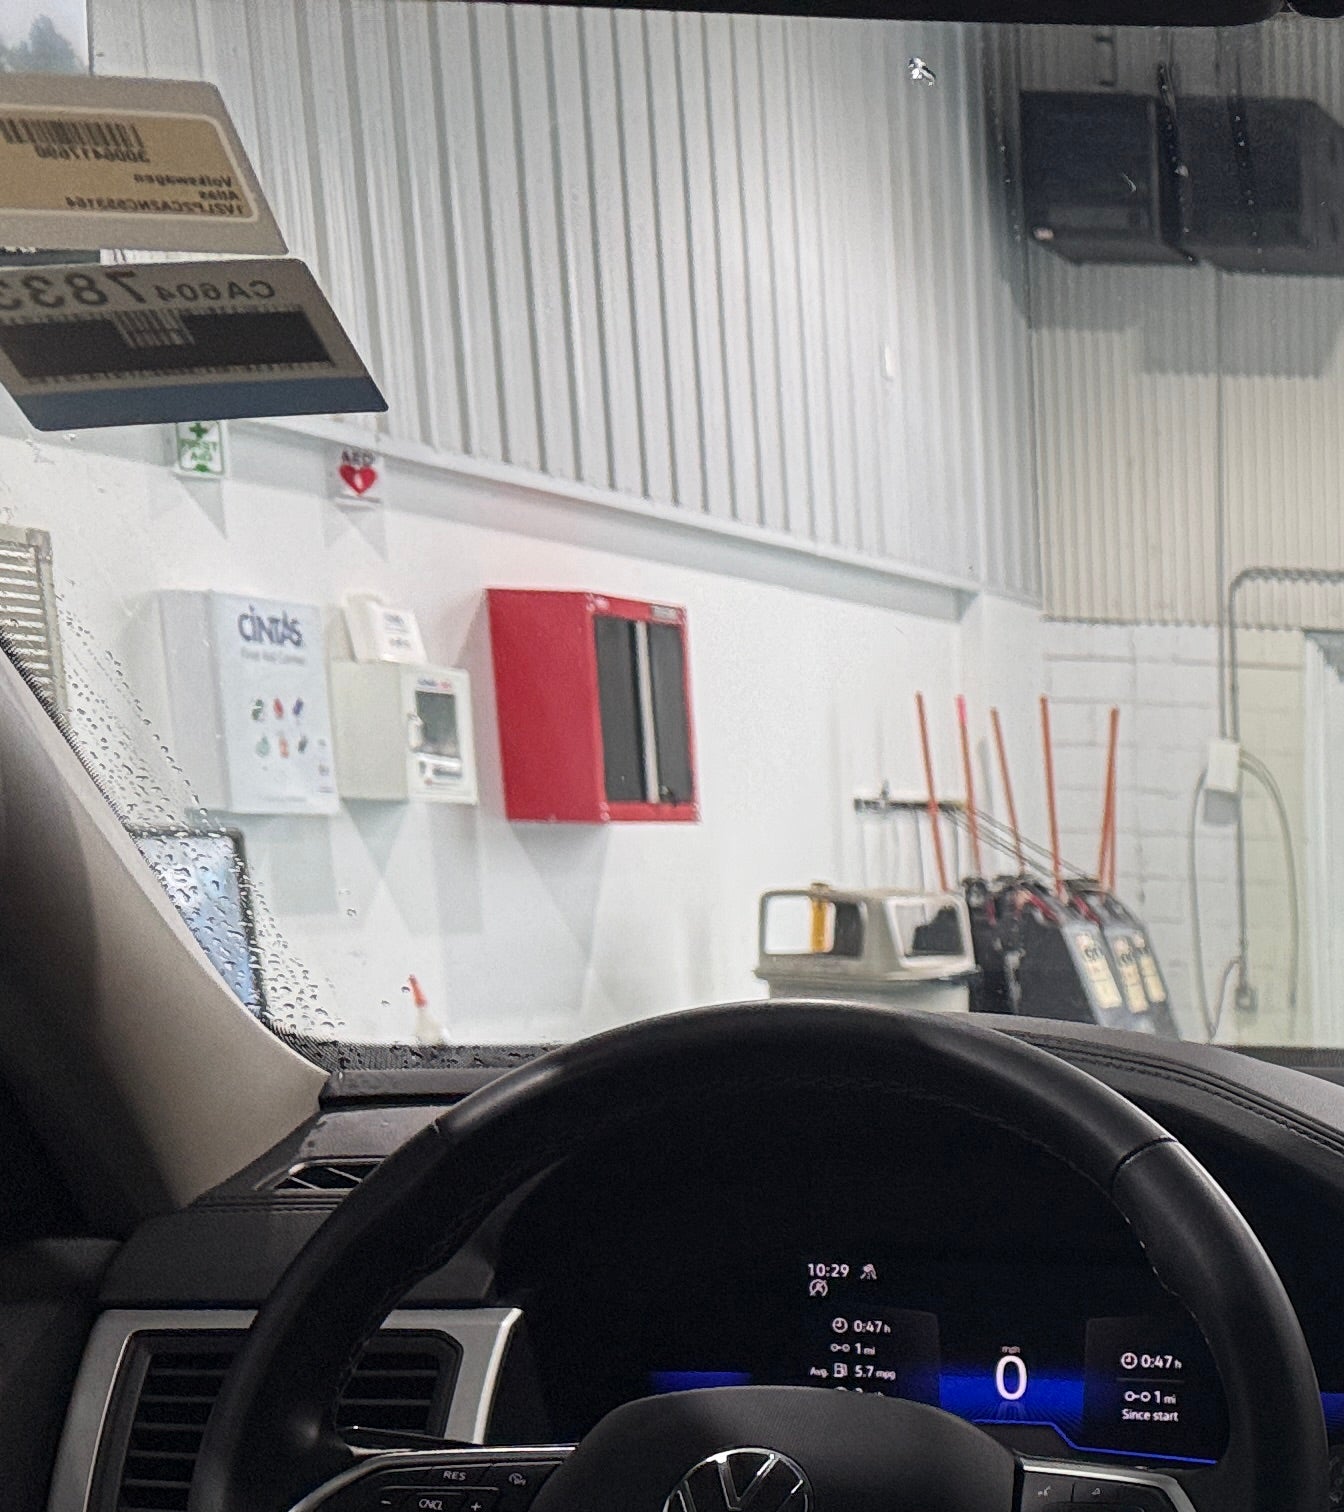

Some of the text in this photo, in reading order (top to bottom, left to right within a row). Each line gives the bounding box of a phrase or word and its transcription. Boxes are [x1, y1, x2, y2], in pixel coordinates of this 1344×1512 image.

[807, 1263, 850, 1278] 10:29
[853, 1319, 883, 1333] 0:47
[855, 1342, 862, 1355] 1
[1140, 1354, 1173, 1369] 0:47
[855, 1364, 875, 1378] 5.7
[996, 1355, 1028, 1401] 0
[1153, 1390, 1176, 1405] 1 mi
[1122, 1408, 1179, 1422] Since start
[443, 1470, 467, 1481] RES
